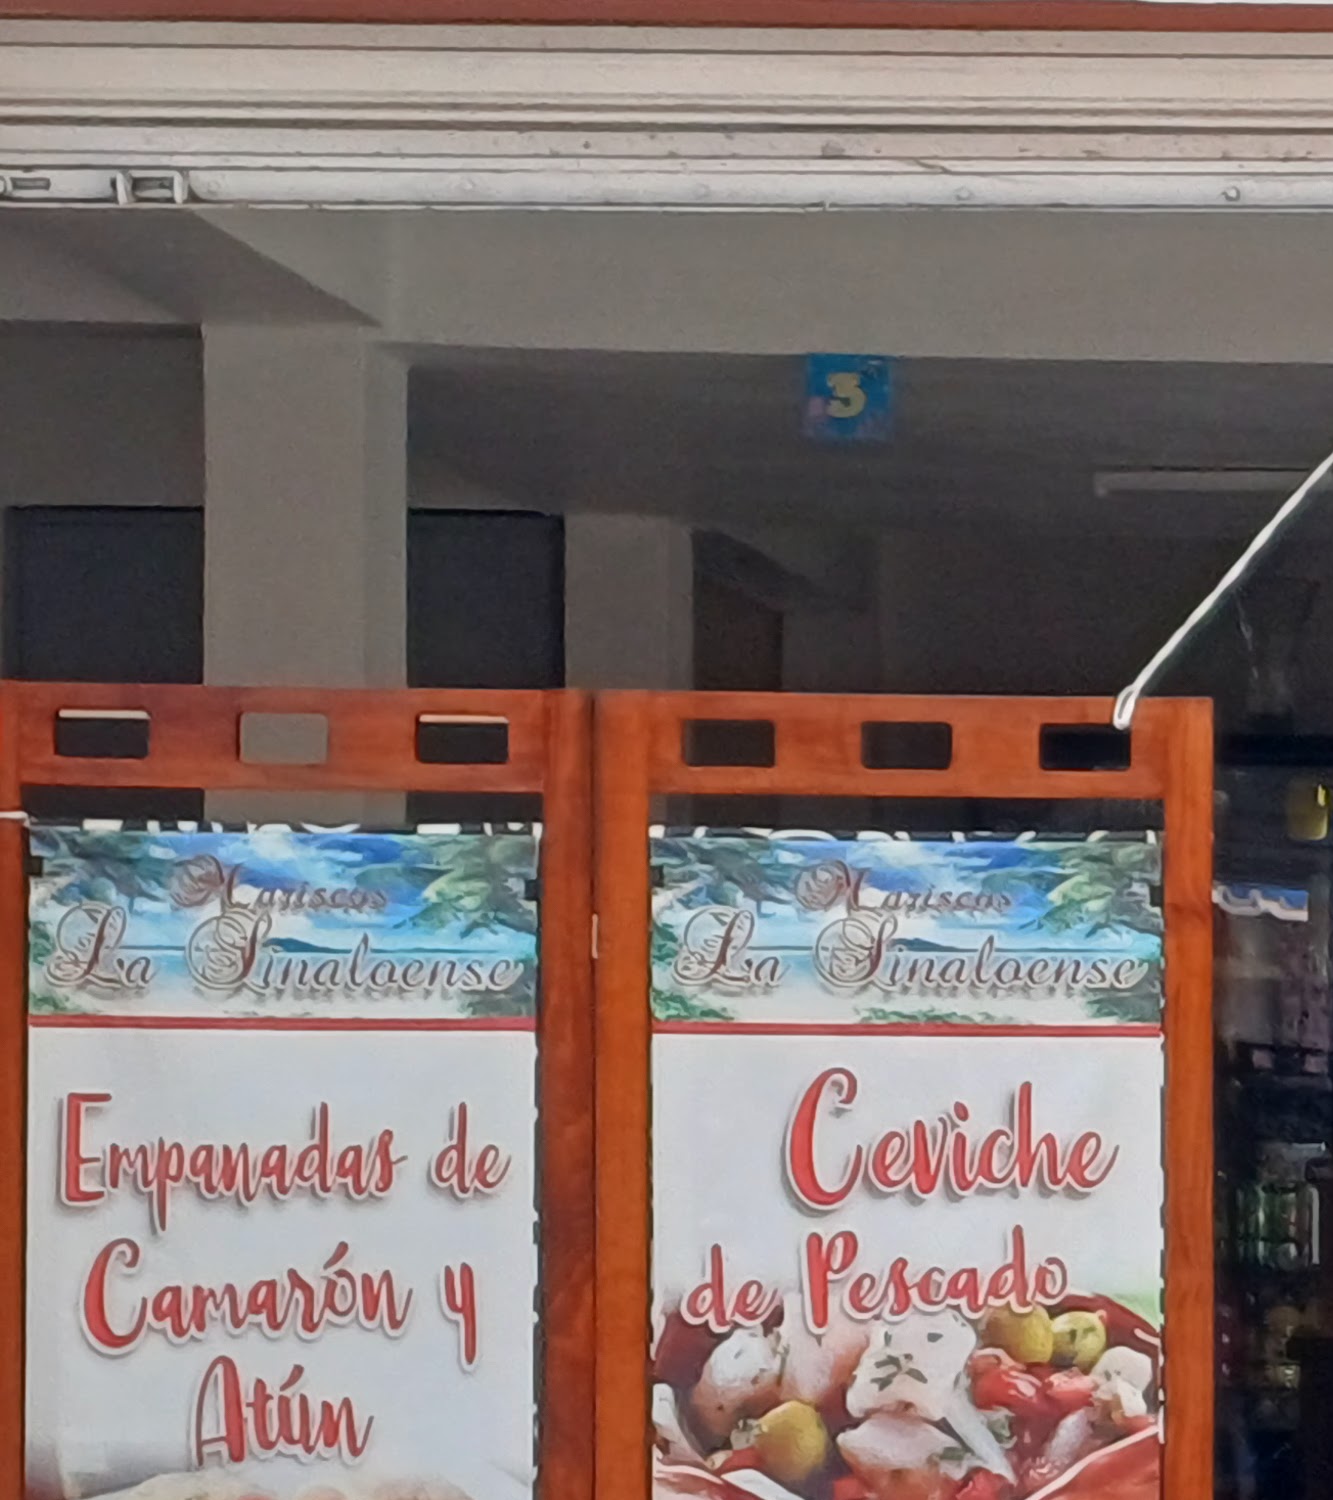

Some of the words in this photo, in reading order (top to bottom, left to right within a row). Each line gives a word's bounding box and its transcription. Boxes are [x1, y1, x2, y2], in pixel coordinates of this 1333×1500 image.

[46, 900, 156, 990] La
[184, 908, 524, 994] Sinaloense
[672, 904, 785, 988] La
[813, 910, 1150, 994] Sinaloense
[60, 1092, 408, 1233] Empanadas
[433, 1102, 513, 1198] de
[782, 1066, 1118, 1208] Ceviche
[82, 1237, 413, 1352] Camarón
[443, 1260, 479, 1366] y
[684, 1243, 779, 1327] de
[804, 1224, 1070, 1330] Pescado
[195, 1355, 376, 1465] Atún
